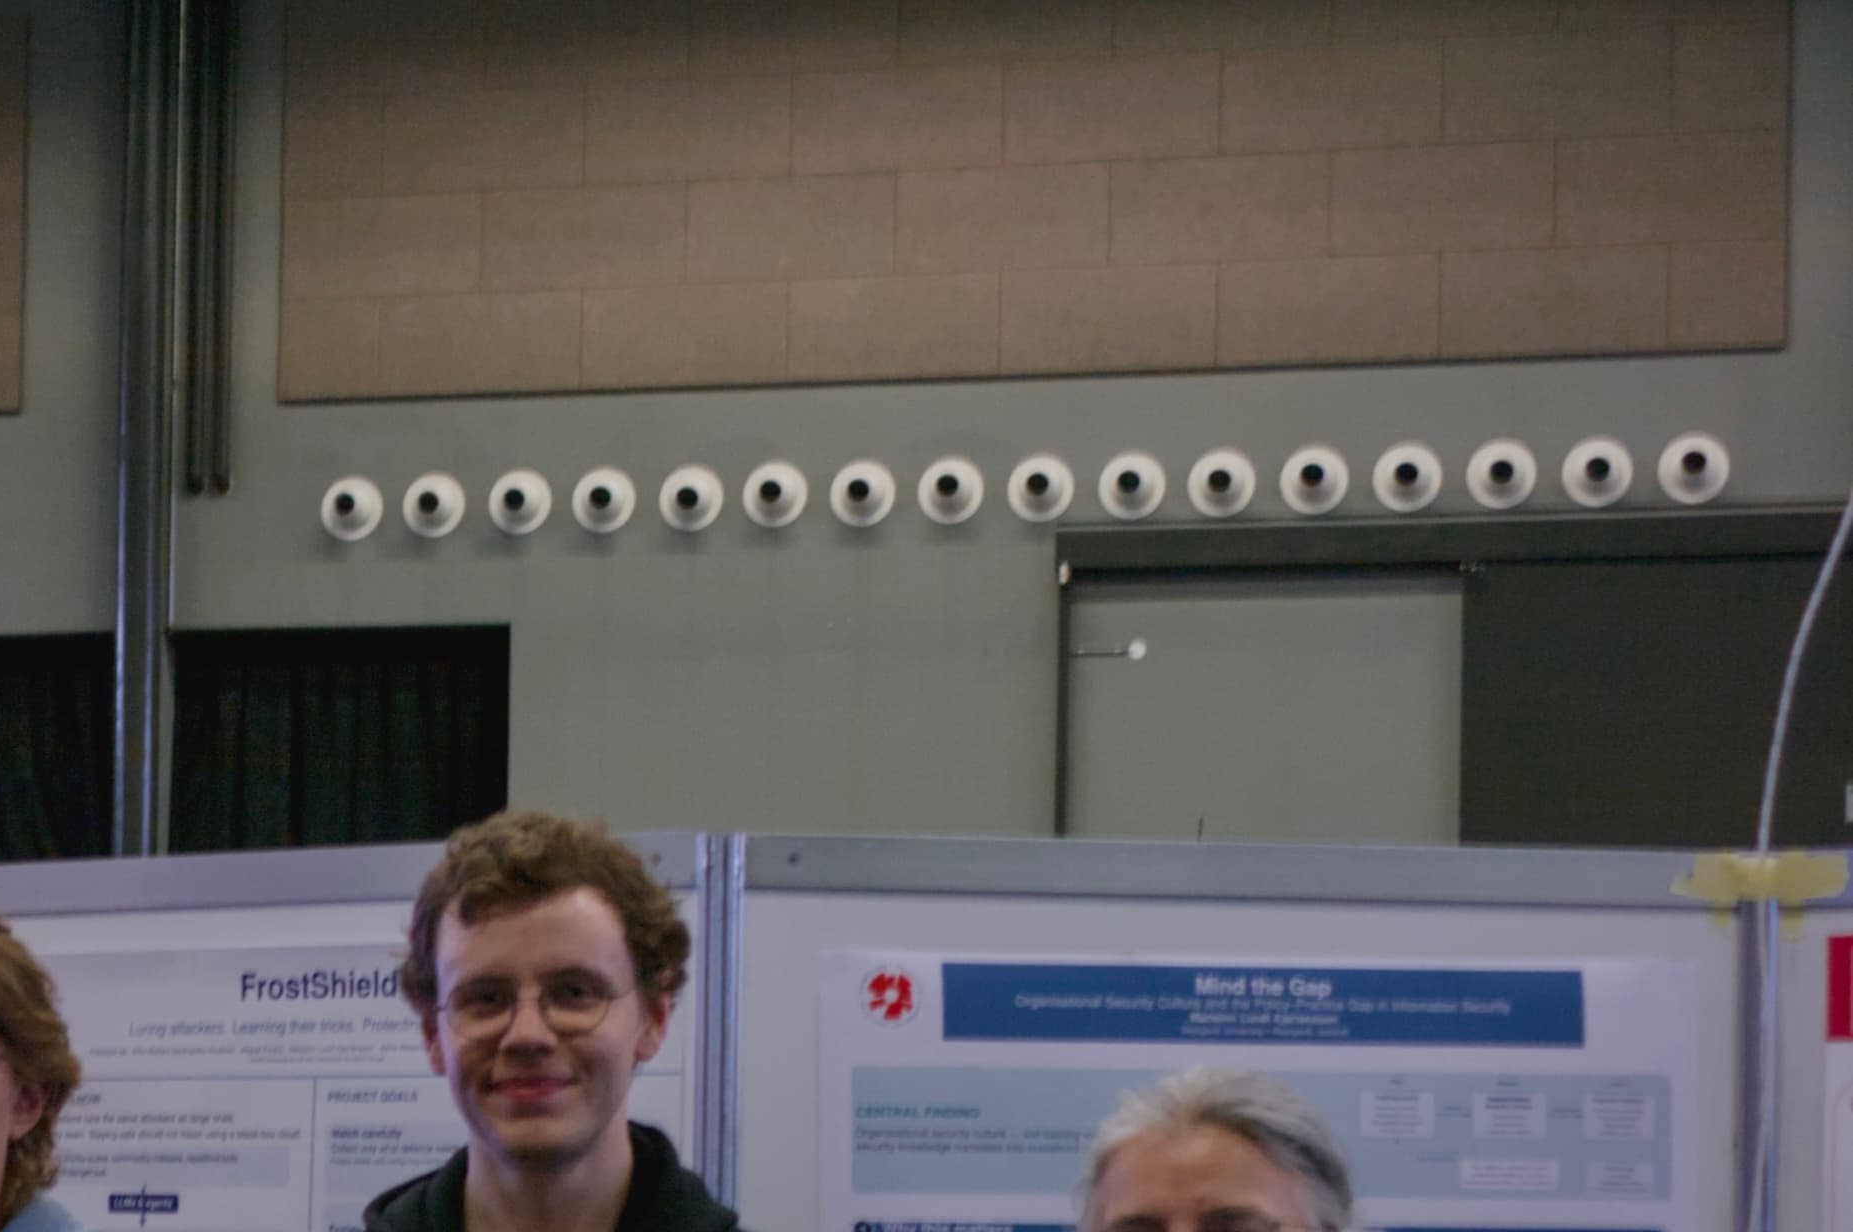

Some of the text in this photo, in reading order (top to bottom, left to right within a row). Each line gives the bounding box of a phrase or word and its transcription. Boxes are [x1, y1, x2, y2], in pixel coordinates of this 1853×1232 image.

[241, 970, 398, 1002] FrostShield
[1195, 976, 1333, 1001] Mind the Gap
